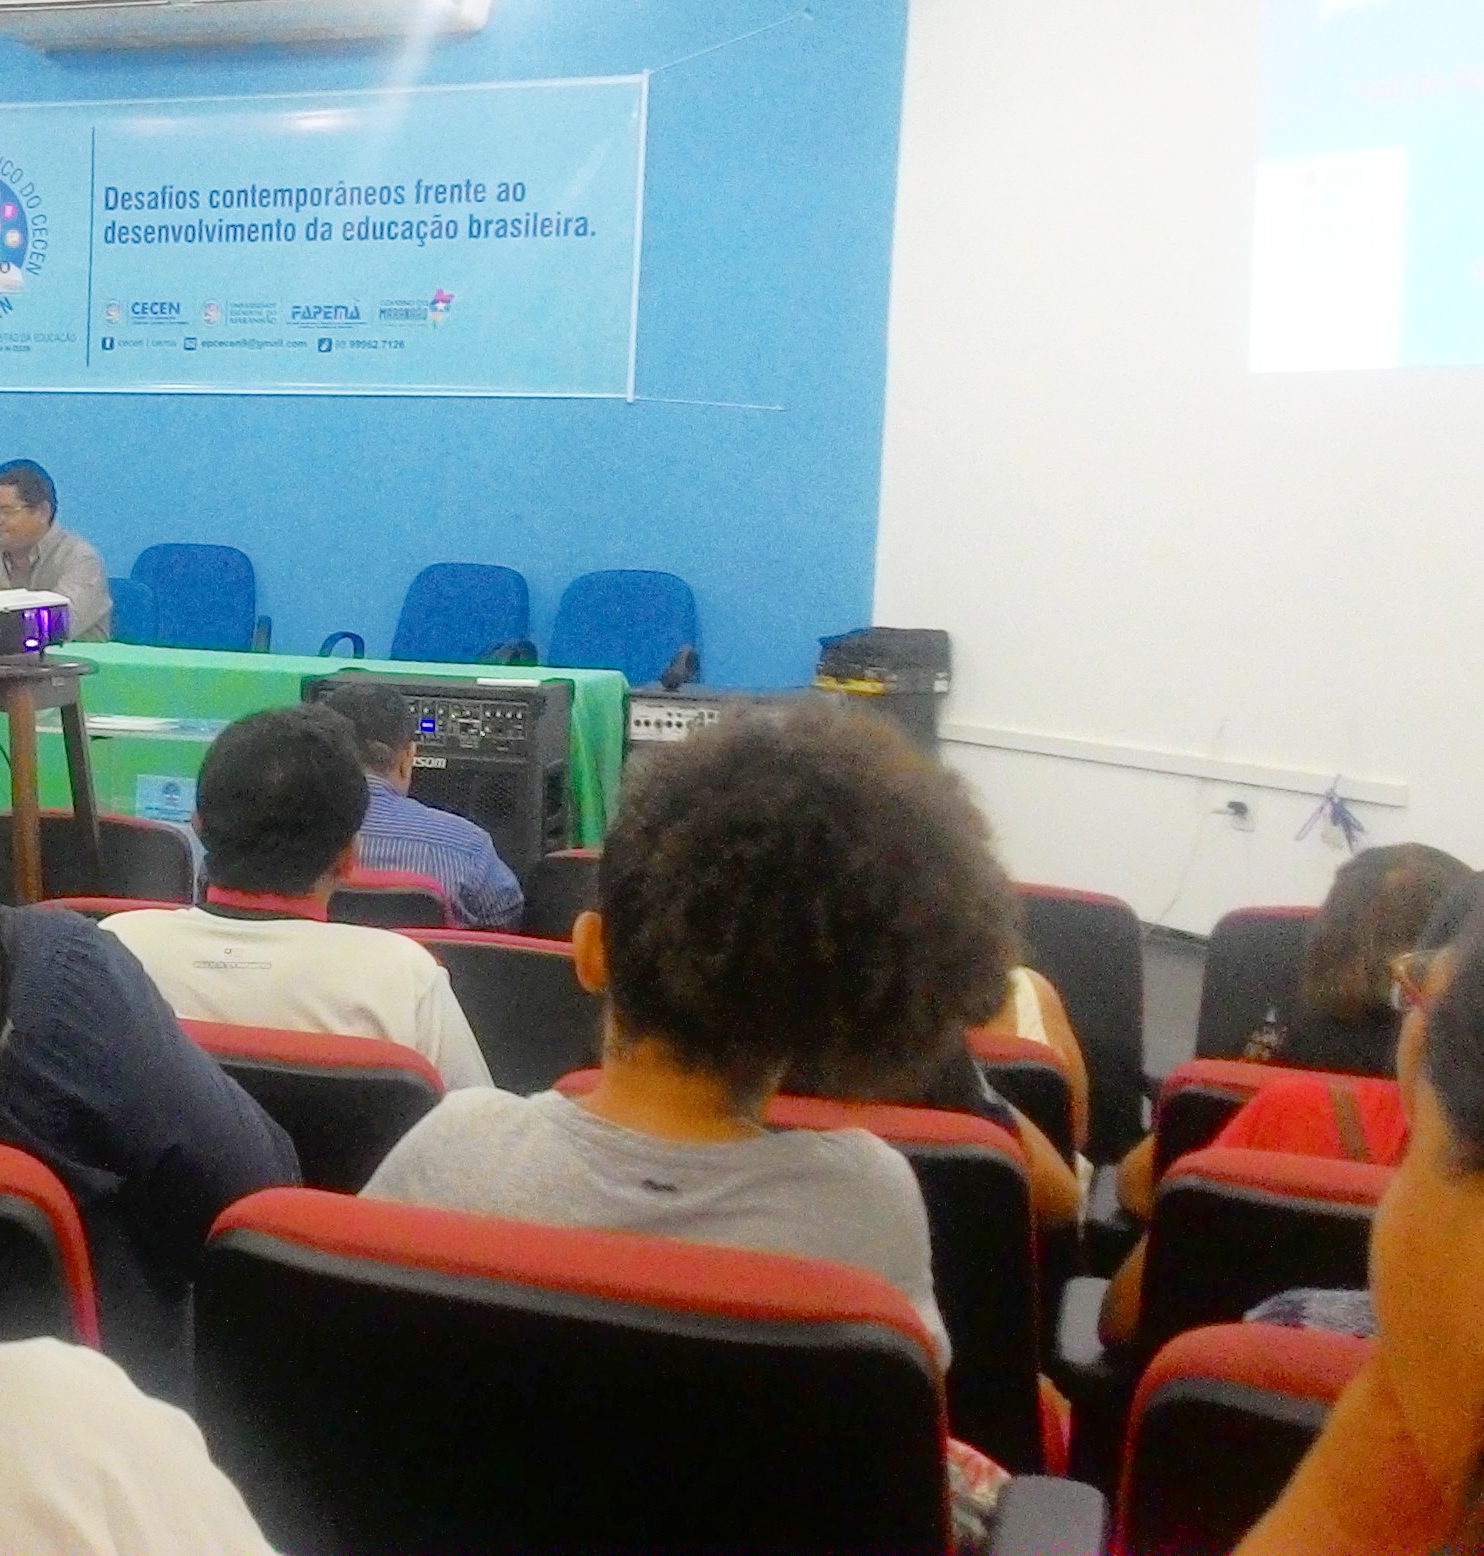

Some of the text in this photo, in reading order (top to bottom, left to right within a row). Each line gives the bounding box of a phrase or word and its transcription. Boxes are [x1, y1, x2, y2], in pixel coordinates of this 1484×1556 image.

[20, 182, 42, 209] DO
[104, 178, 526, 213] Desafios contemporâneos frente ao
[25, 214, 48, 276] CECEN
[104, 211, 596, 247] desenvolvimento da educação brasileira.
[131, 302, 181, 315] CECEN
